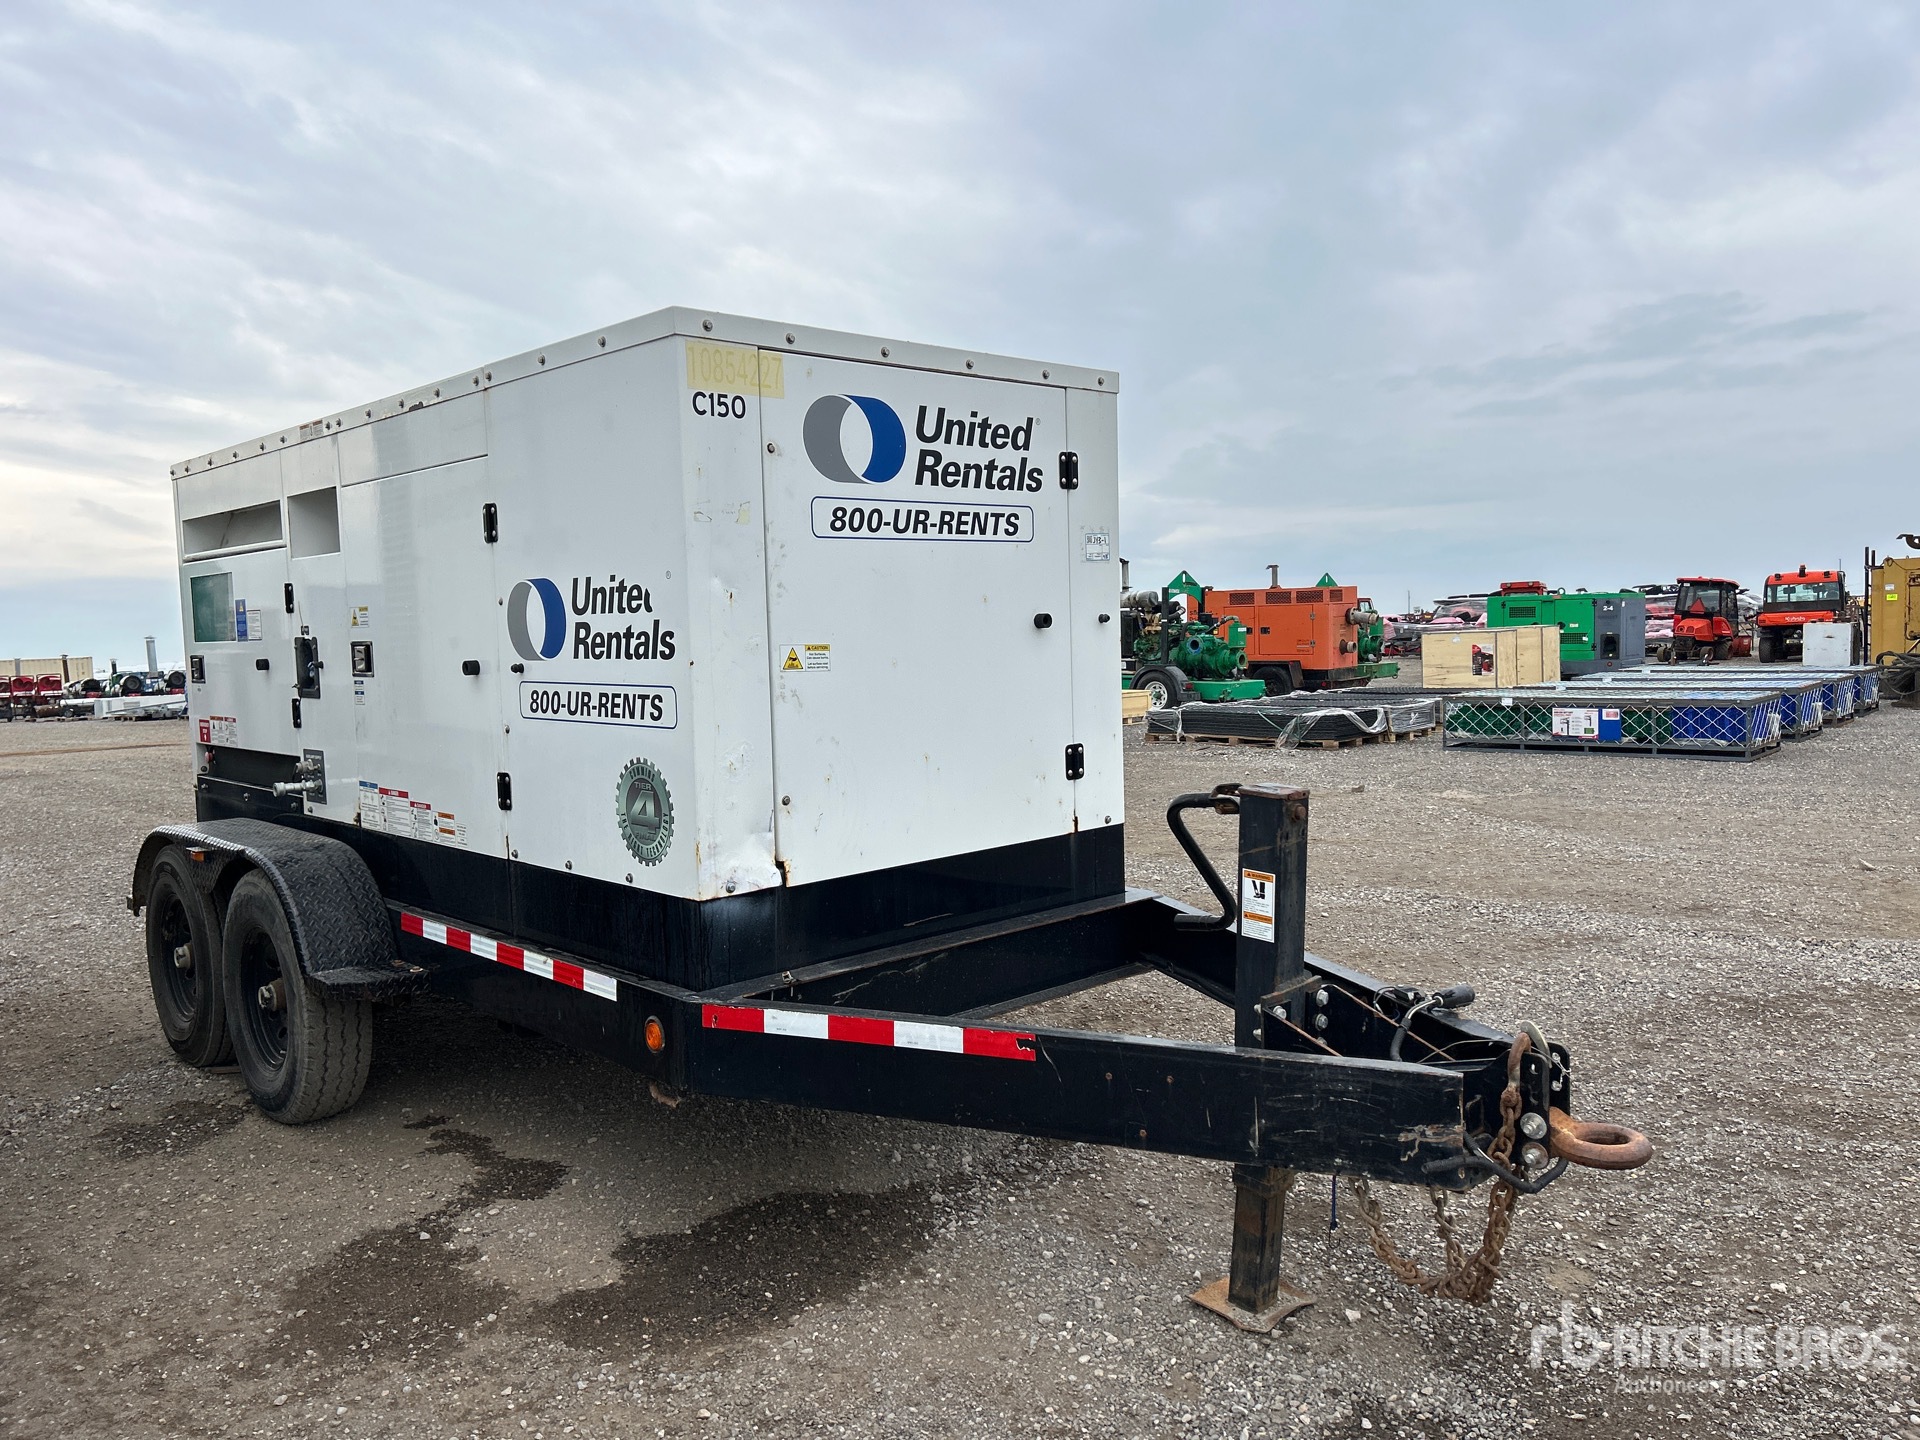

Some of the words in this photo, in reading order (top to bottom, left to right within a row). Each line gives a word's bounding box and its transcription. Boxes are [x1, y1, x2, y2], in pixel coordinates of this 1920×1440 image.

[687, 346, 782, 390] 10854227
[692, 391, 746, 419] C150
[915, 405, 1034, 452] United
[915, 448, 1043, 492] Rentals
[829, 506, 1020, 537] 800-UR-RENTS
[573, 619, 676, 660] Rentals
[529, 689, 663, 721] 800-UR-RENTS
[634, 781, 652, 791] TIER
[630, 790, 660, 835] 4
